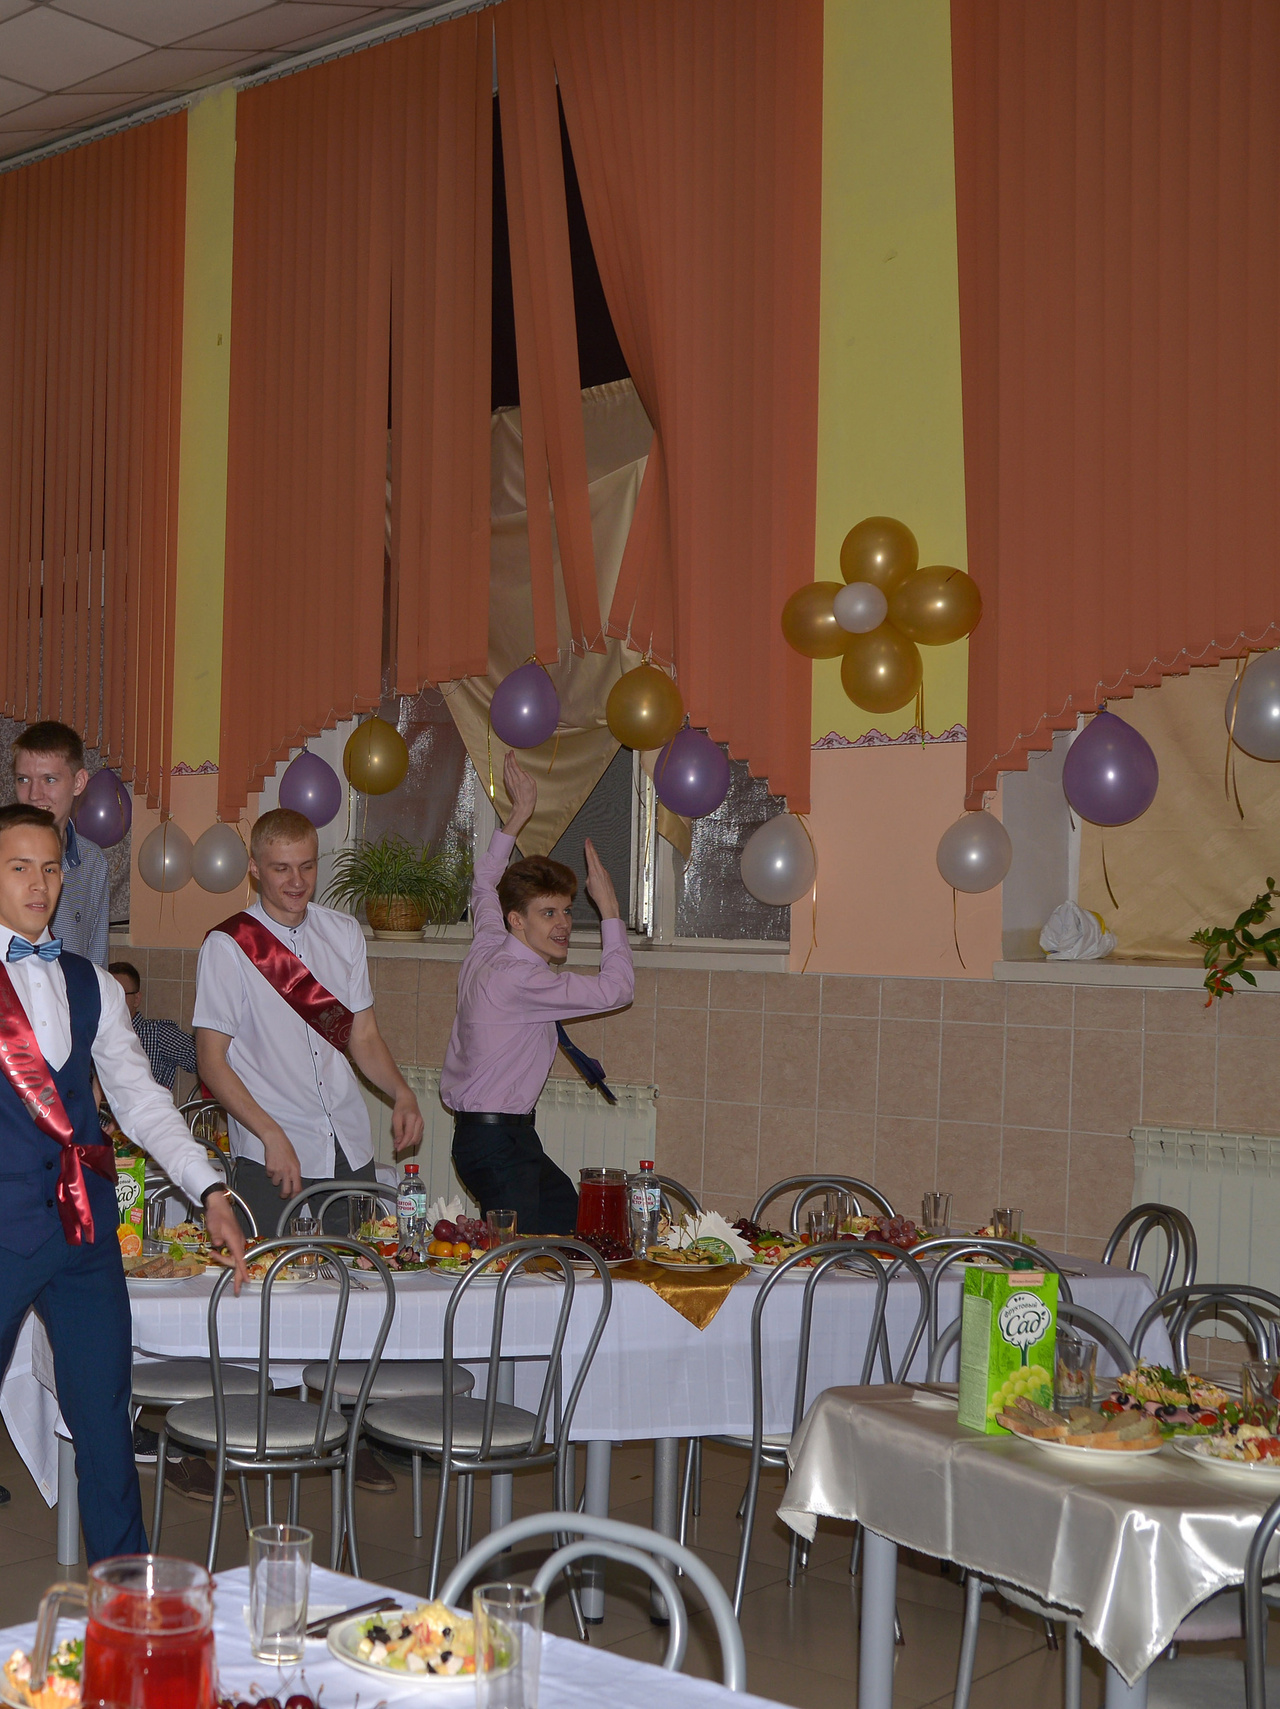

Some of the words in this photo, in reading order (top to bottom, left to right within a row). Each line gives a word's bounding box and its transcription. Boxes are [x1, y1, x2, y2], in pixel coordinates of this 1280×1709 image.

[1, 1039, 44, 1089] 2019
[115, 1185, 133, 1203] ад
[1004, 1302, 1038, 1318] фруктовый
[1006, 1310, 1042, 1336] Сад
